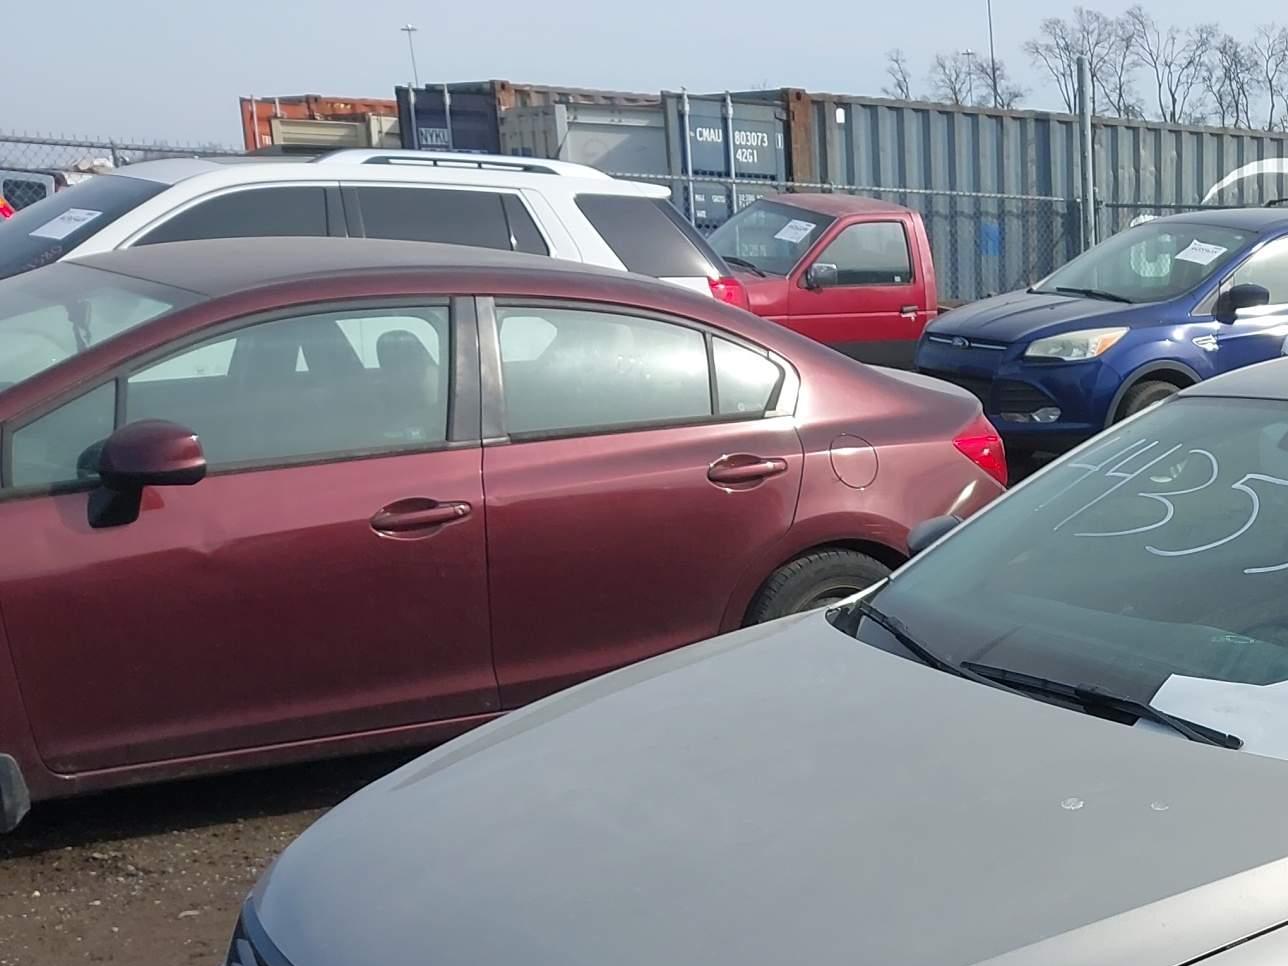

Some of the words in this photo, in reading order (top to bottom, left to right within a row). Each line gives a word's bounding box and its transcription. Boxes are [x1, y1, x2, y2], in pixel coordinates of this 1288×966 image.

[696, 127, 723, 142] CMAU
[734, 131, 769, 147] 803073
[735, 149, 758, 163] 42G1
